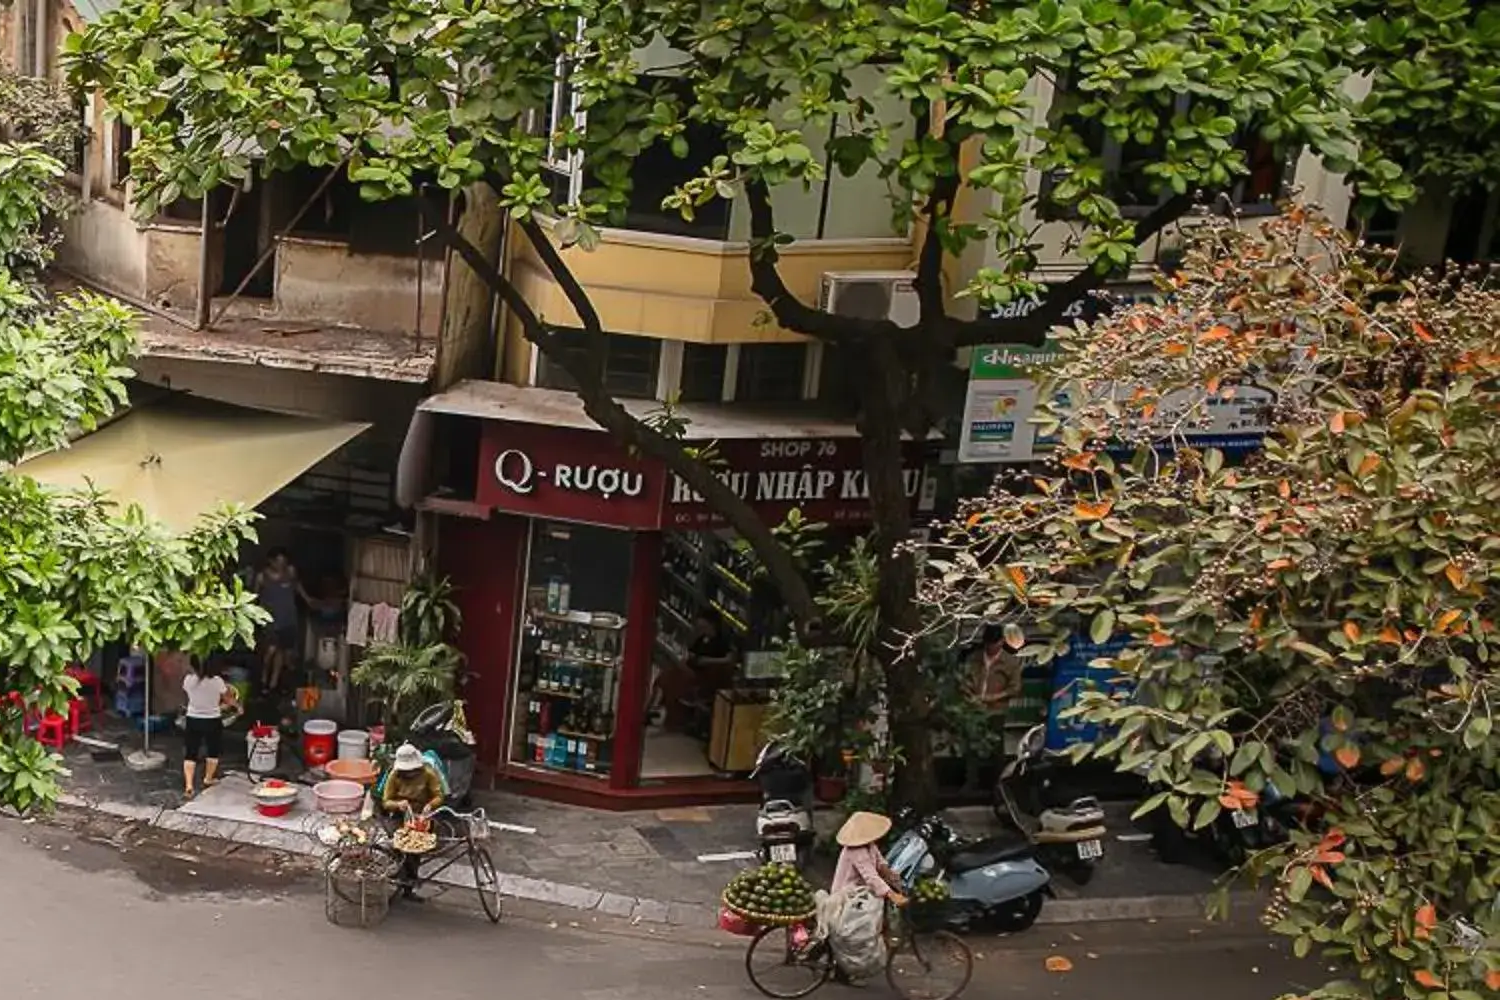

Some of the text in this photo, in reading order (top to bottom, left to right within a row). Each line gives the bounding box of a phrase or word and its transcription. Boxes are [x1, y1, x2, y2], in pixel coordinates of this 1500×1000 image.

[760, 441, 811, 458] SHOP
[755, 463, 835, 507] NHẬP
[841, 468, 921, 500] KU
